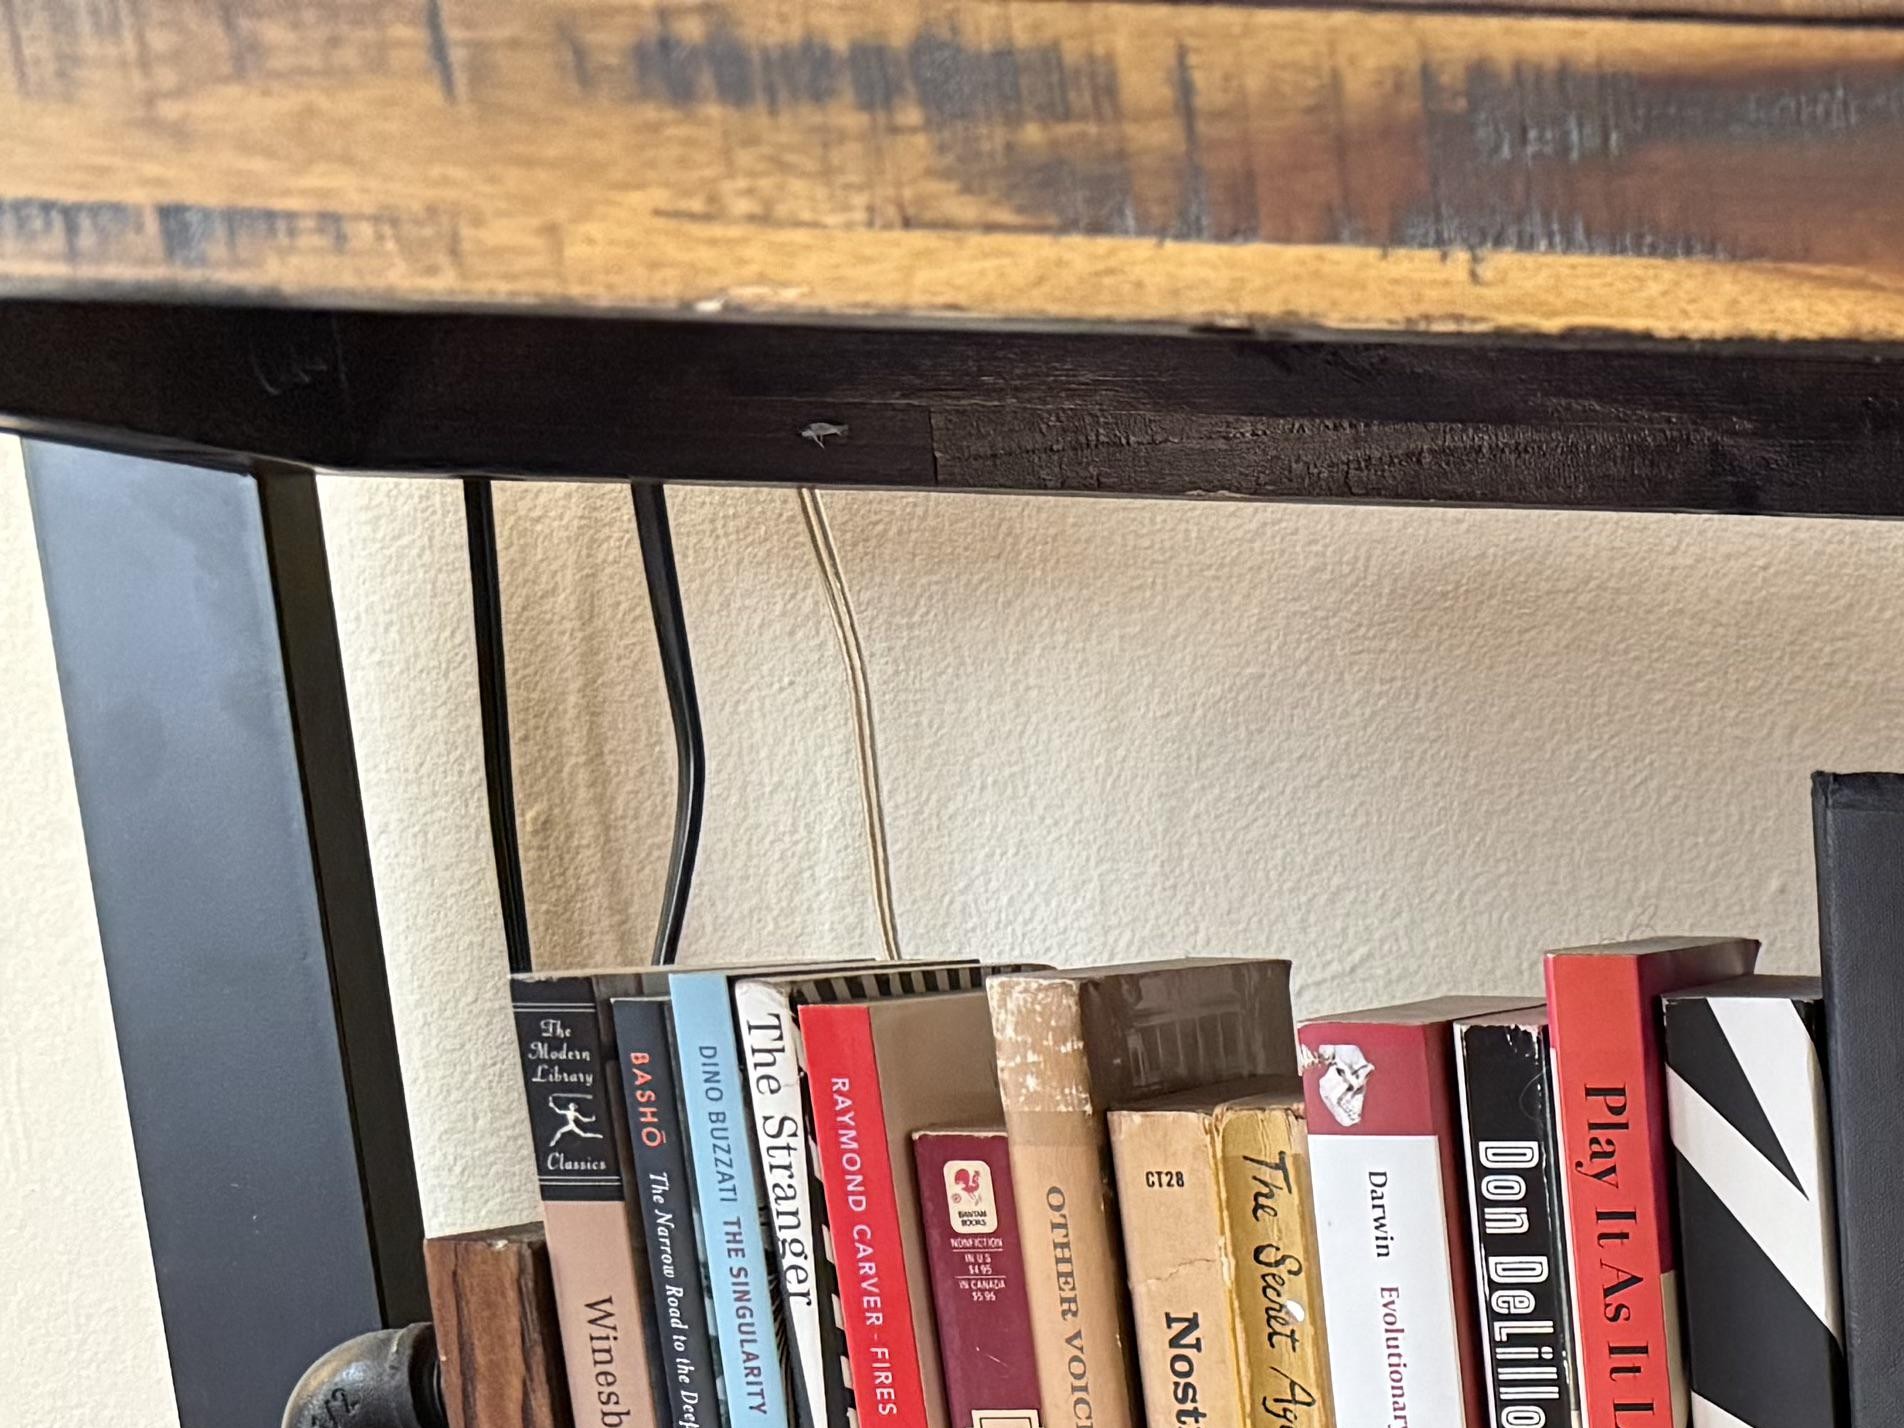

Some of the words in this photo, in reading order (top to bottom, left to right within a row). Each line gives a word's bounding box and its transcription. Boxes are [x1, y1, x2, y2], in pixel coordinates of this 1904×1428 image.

[528, 1042, 592, 1062] Modern
[540, 1019, 572, 1039] The
[746, 1012, 784, 1096] The
[531, 1064, 595, 1087] Library
[629, 1051, 667, 1149] BASHŌ
[699, 1045, 724, 1102] DINO
[546, 1151, 607, 1172] Classics
[706, 1109, 739, 1204] BUZZATI
[1575, 1081, 1630, 1189] Play
[1145, 1169, 1185, 1189] CT28
[722, 1216, 746, 1256] THE
[761, 1114, 812, 1308] Stranger
[1366, 1171, 1392, 1258] Darwin
[1594, 1206, 1639, 1255] It
[831, 1076, 868, 1212] RAYMOND
[852, 1221, 882, 1326] CARVER
[869, 1345, 898, 1417] FIRES
[1599, 1262, 1632, 1325] As
[728, 1264, 768, 1416] SINGULARITY
[1605, 1339, 1651, 1382] It
